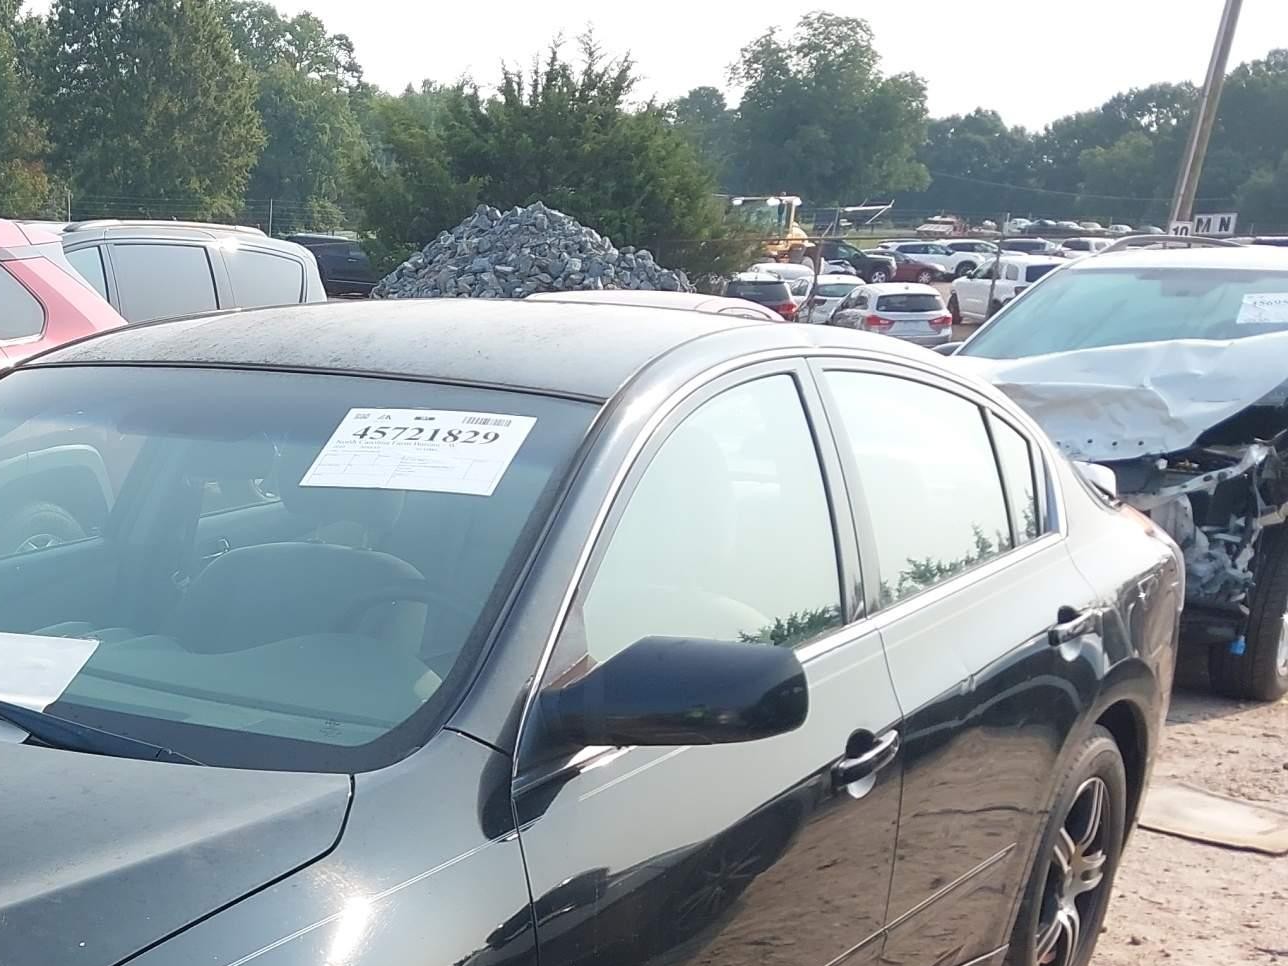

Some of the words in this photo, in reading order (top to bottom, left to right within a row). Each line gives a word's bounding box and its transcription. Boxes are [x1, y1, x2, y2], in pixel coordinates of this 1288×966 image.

[1195, 217, 1212, 232] M
[1218, 216, 1232, 232] N
[352, 425, 500, 445] 45721829
